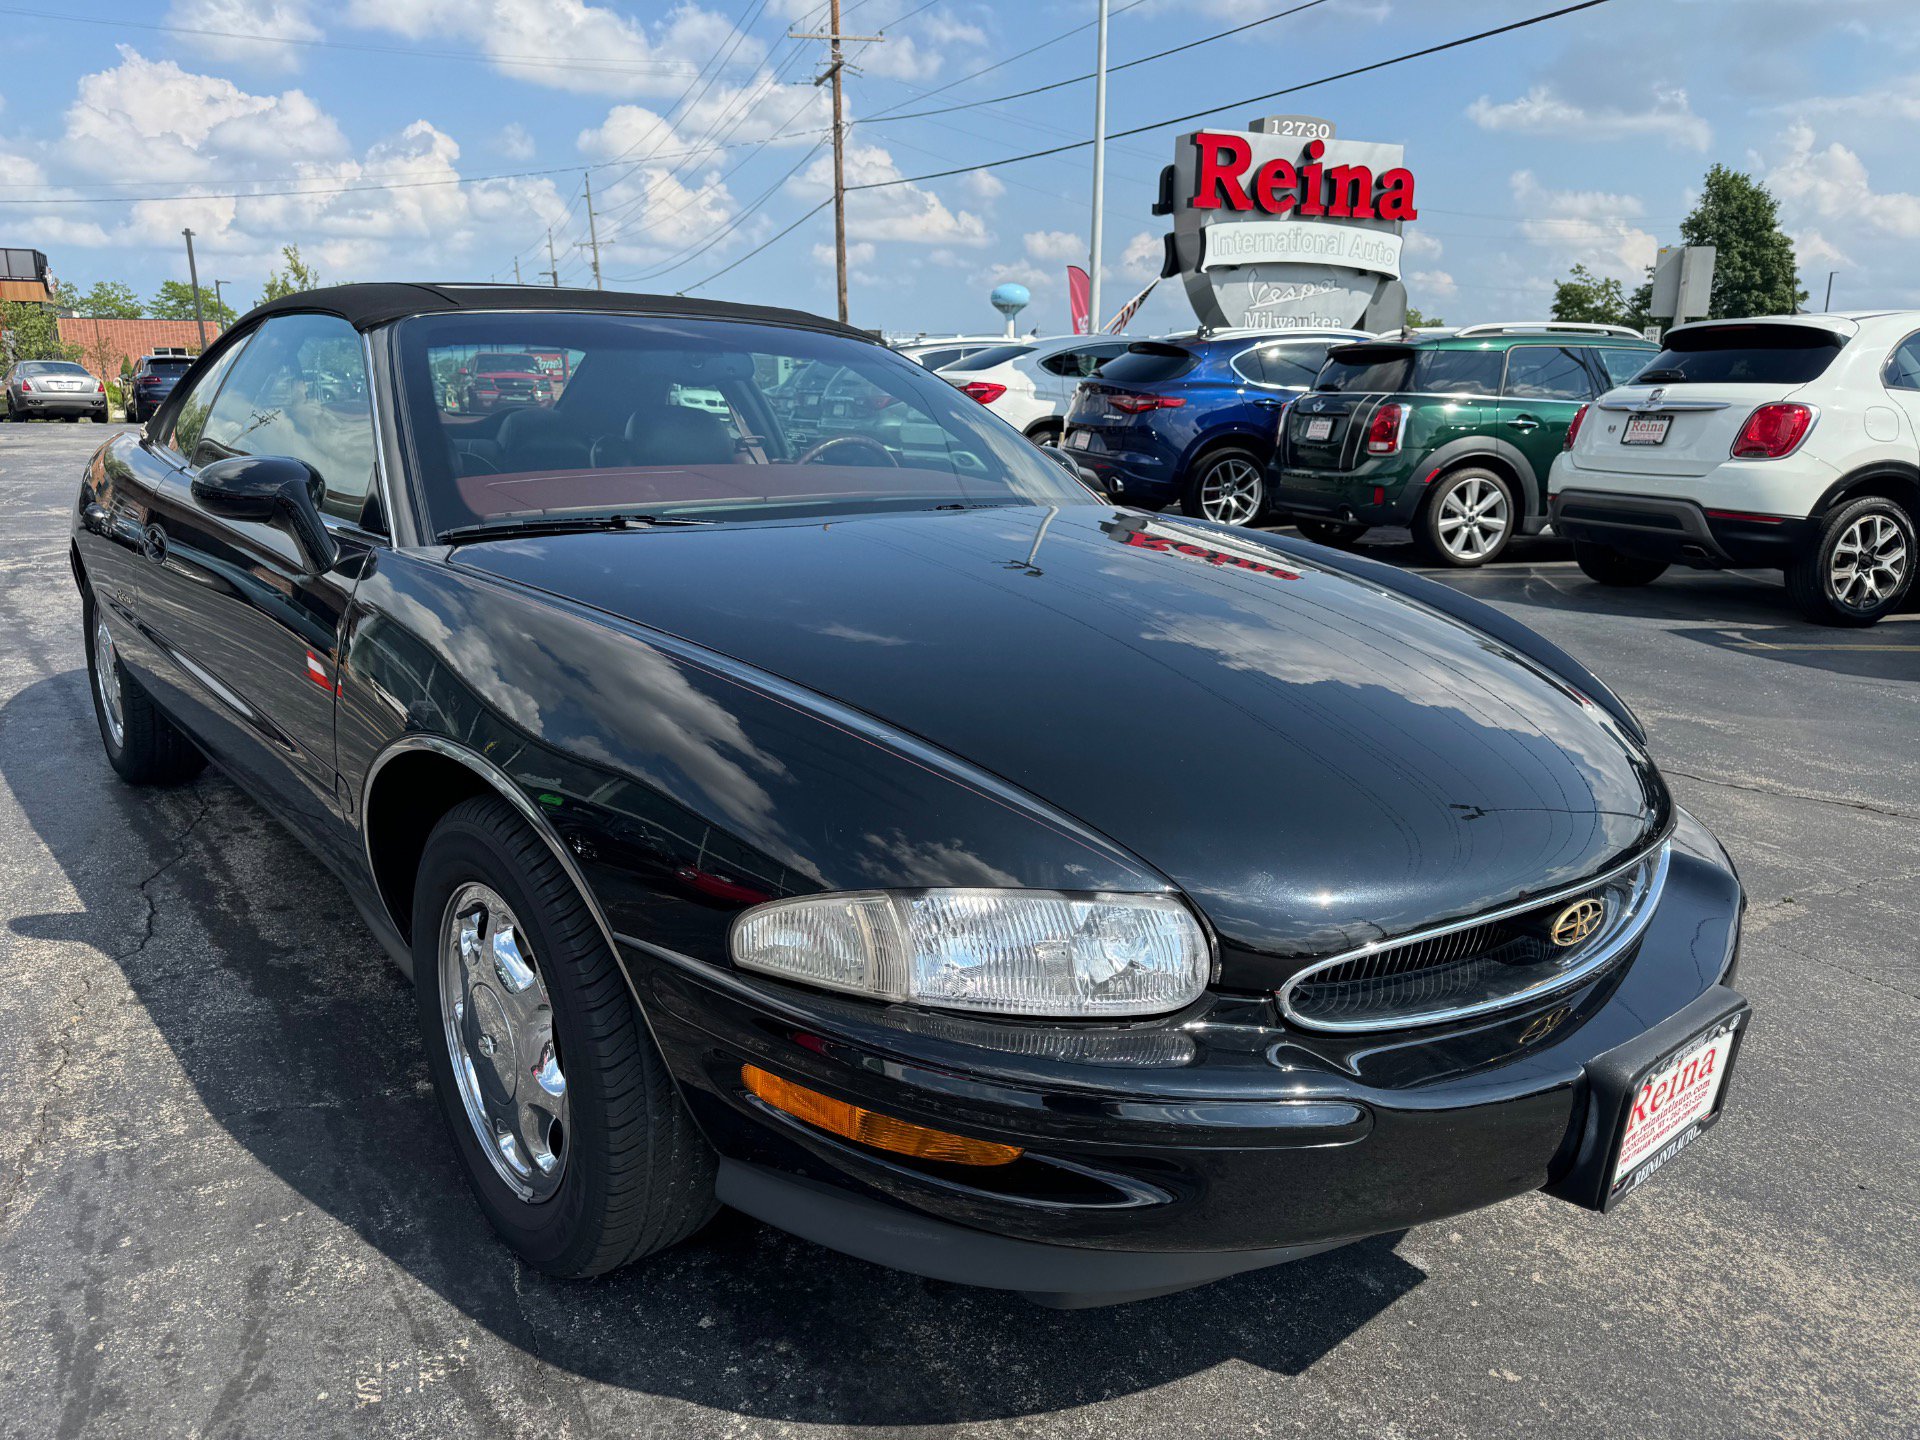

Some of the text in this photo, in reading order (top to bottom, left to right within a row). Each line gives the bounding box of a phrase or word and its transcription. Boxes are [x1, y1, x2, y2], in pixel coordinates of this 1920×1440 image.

[1272, 119, 1330, 139] 12730
[1188, 132, 1418, 222] Reina
[1212, 228, 1396, 266] International Auto
[1248, 268, 1341, 309] Vespa
[1243, 311, 1342, 329] Milwaukee
[1631, 420, 1665, 433] Reina
[1625, 1046, 1717, 1134] Reina
